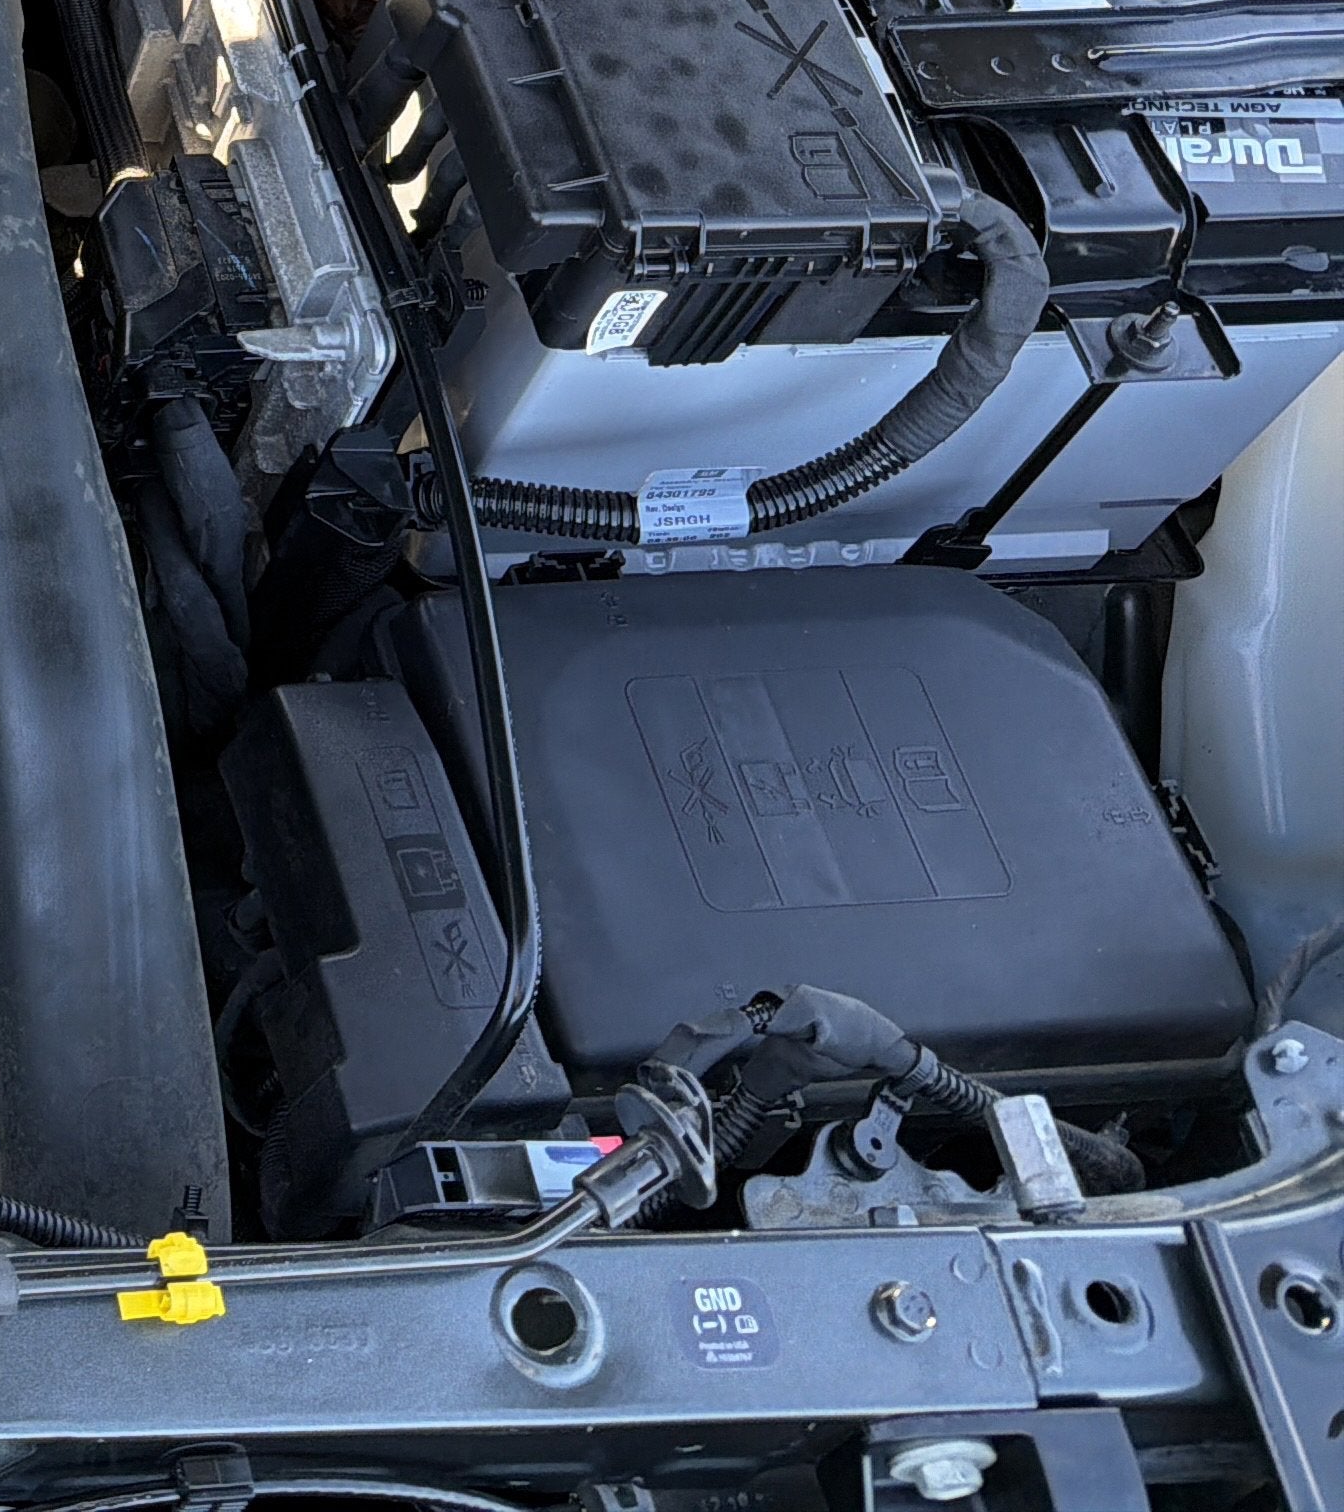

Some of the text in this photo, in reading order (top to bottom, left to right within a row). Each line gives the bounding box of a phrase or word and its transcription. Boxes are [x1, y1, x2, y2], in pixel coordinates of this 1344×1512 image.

[1126, 101, 1281, 114] AGM TECHNO
[1151, 121, 1211, 134] PLAT
[1159, 137, 1323, 175] Dural
[694, 1286, 742, 1312] GND
